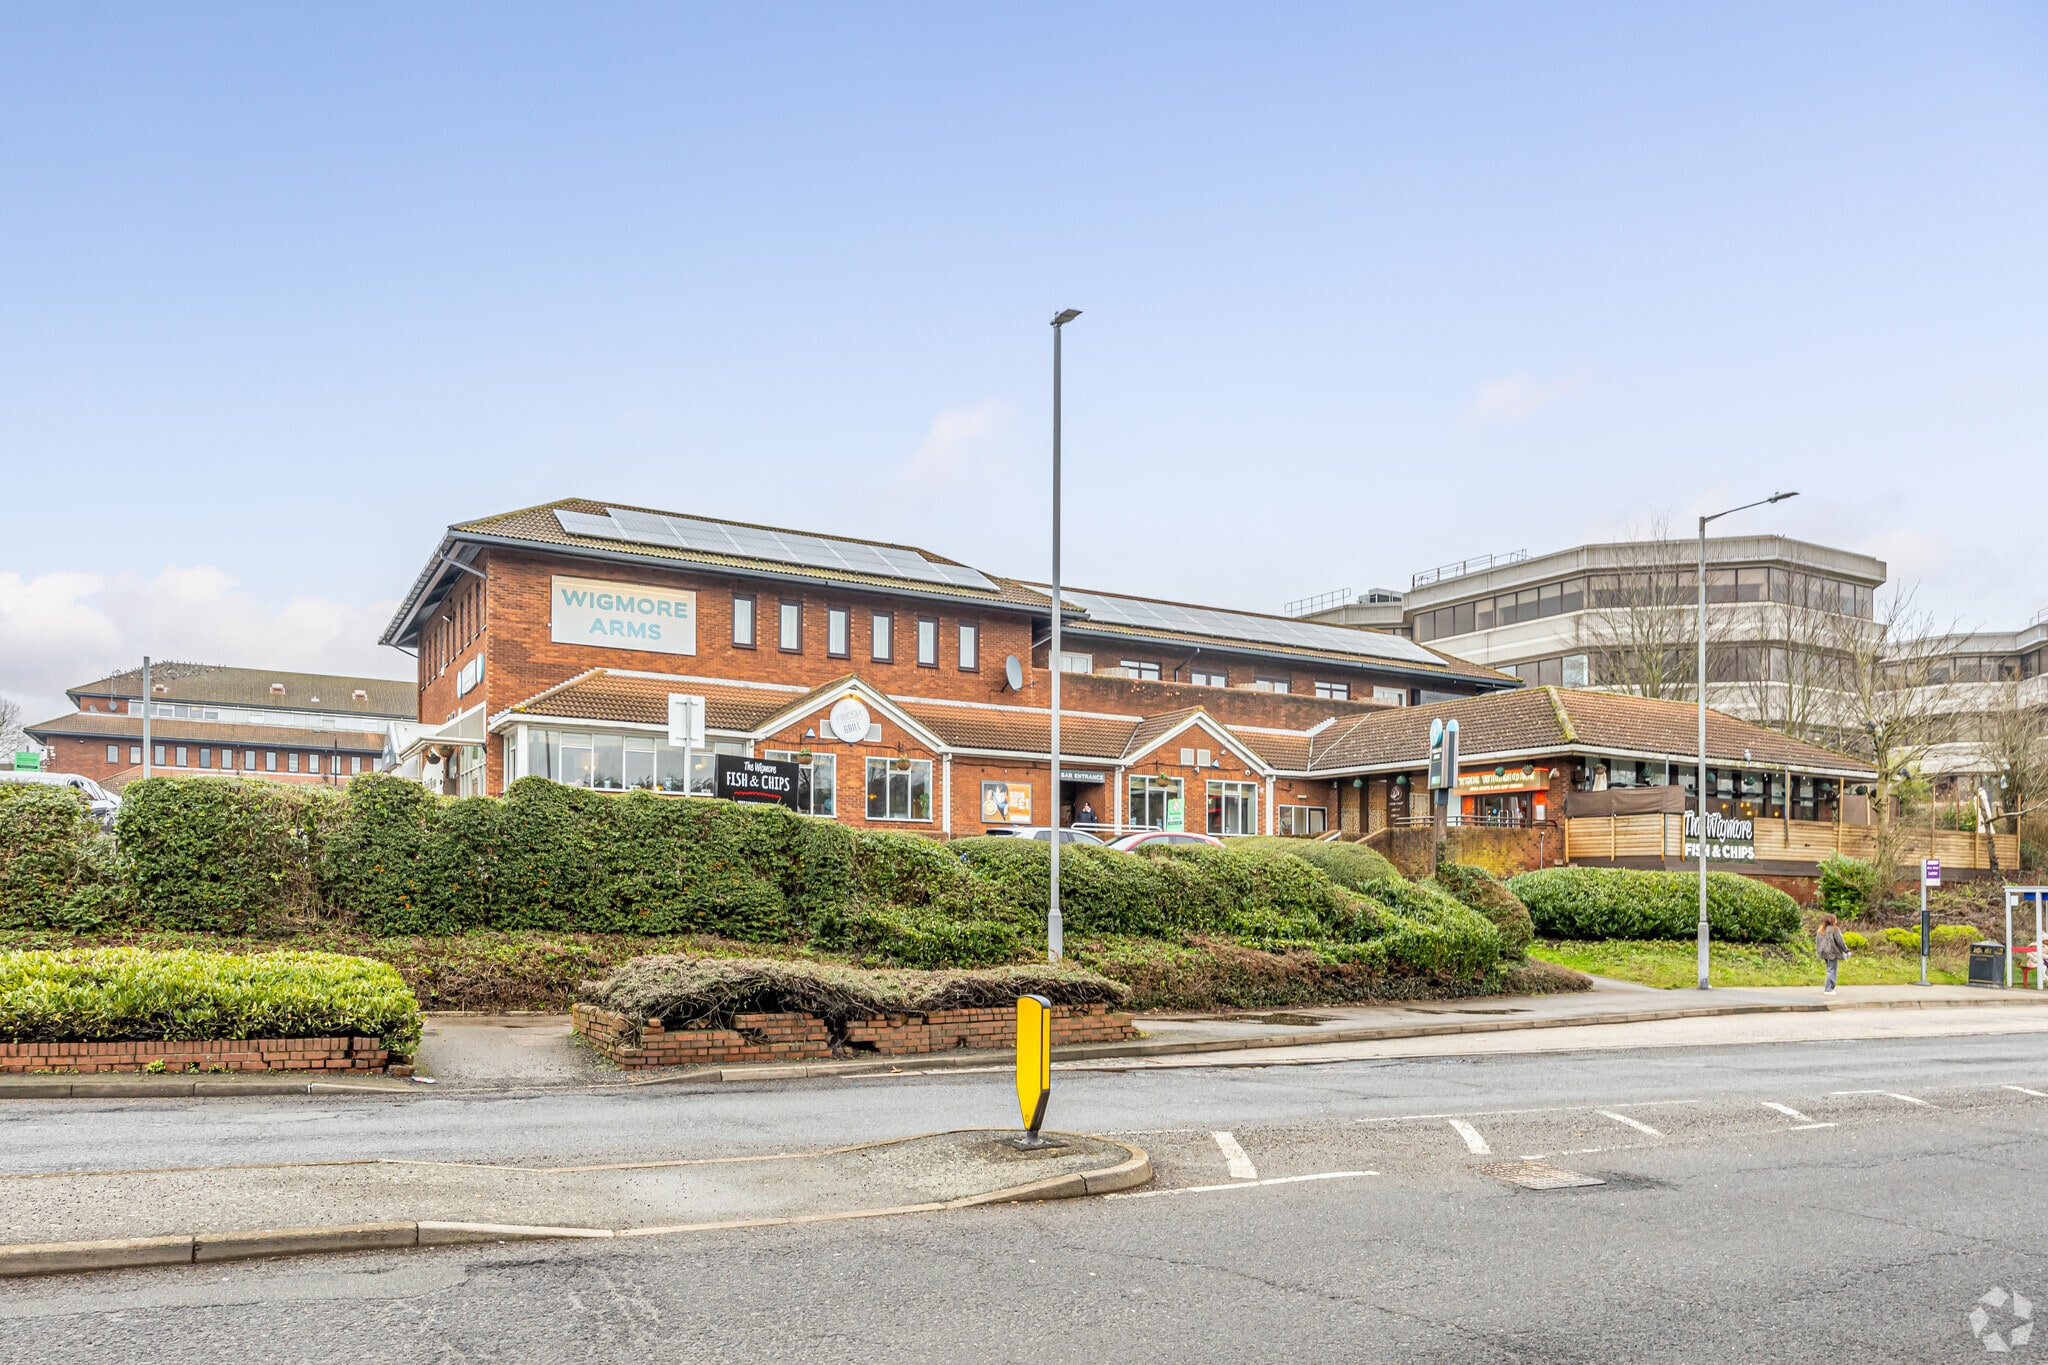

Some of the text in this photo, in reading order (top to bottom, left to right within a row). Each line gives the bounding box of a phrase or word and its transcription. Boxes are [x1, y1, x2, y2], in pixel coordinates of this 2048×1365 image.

[561, 588, 688, 618] WIGMORE
[589, 618, 662, 640] ARMS
[835, 709, 863, 722] FRESH
[843, 721, 861, 733] GRILL
[744, 761, 777, 774] The Wigmore
[726, 771, 790, 792] FISH & CHIPS
[1074, 773, 1103, 781] ENTRANCE
[1705, 812, 1752, 843] Wigmore
[1712, 844, 1721, 857] &
[1722, 845, 1755, 860] CHIPS
